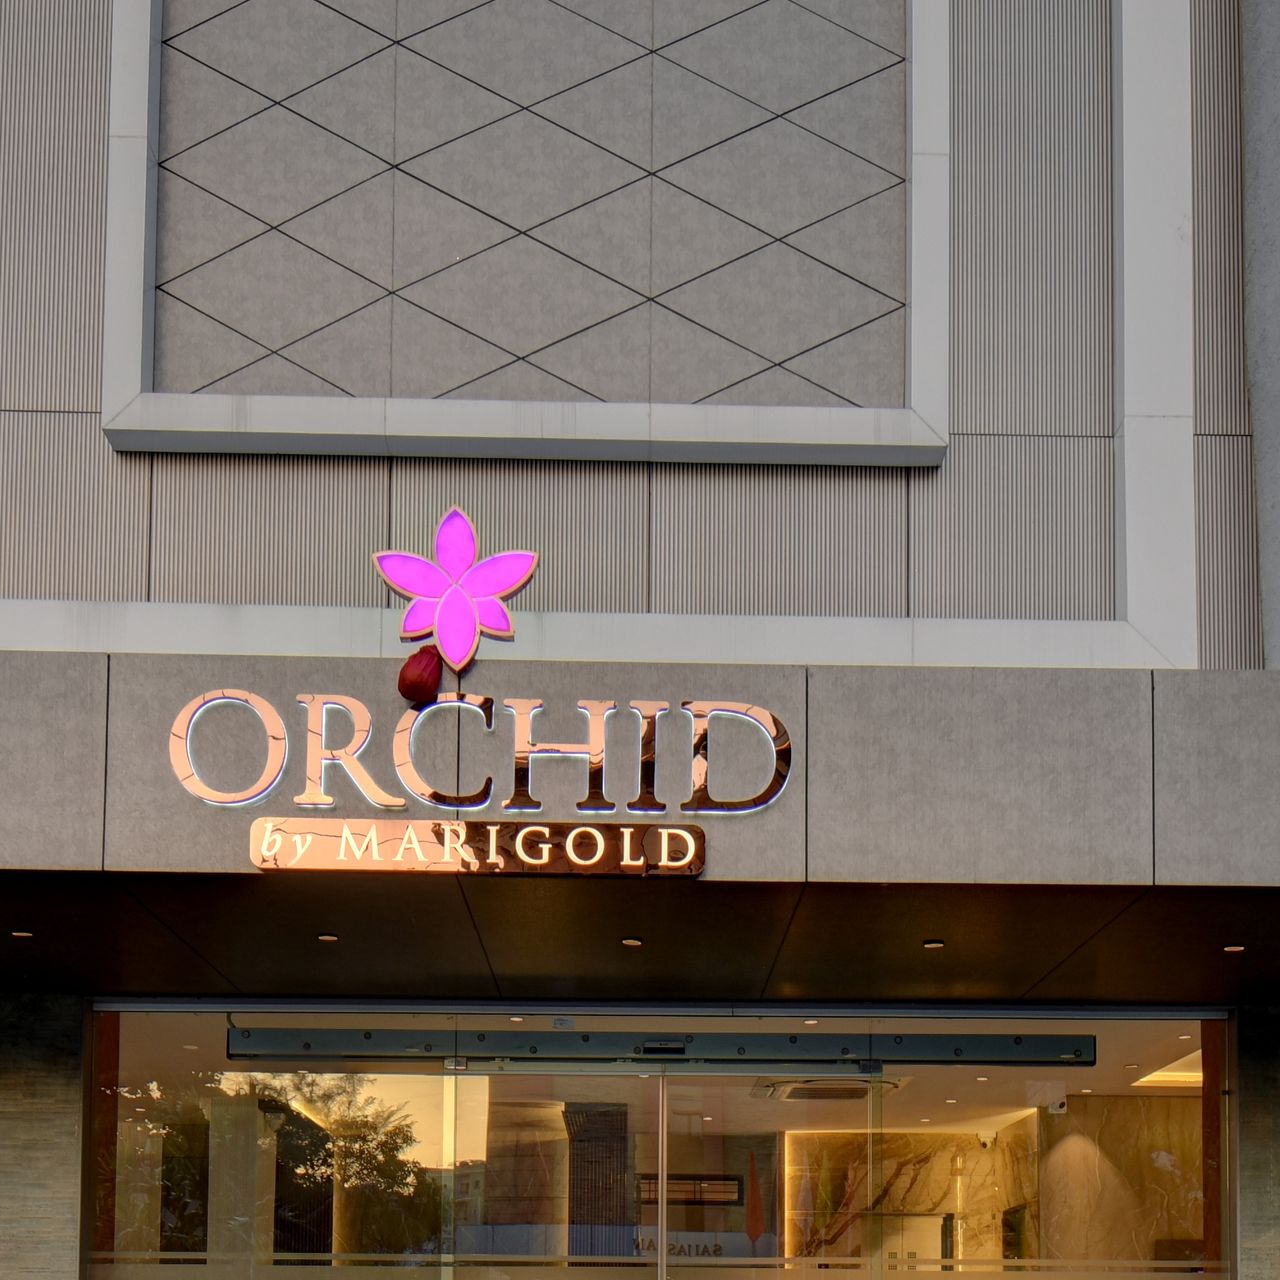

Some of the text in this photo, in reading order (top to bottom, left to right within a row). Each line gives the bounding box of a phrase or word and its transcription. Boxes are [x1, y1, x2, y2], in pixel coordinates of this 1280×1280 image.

[168, 688, 792, 814] ORCHID
[260, 822, 697, 867] by MARIGOLD
